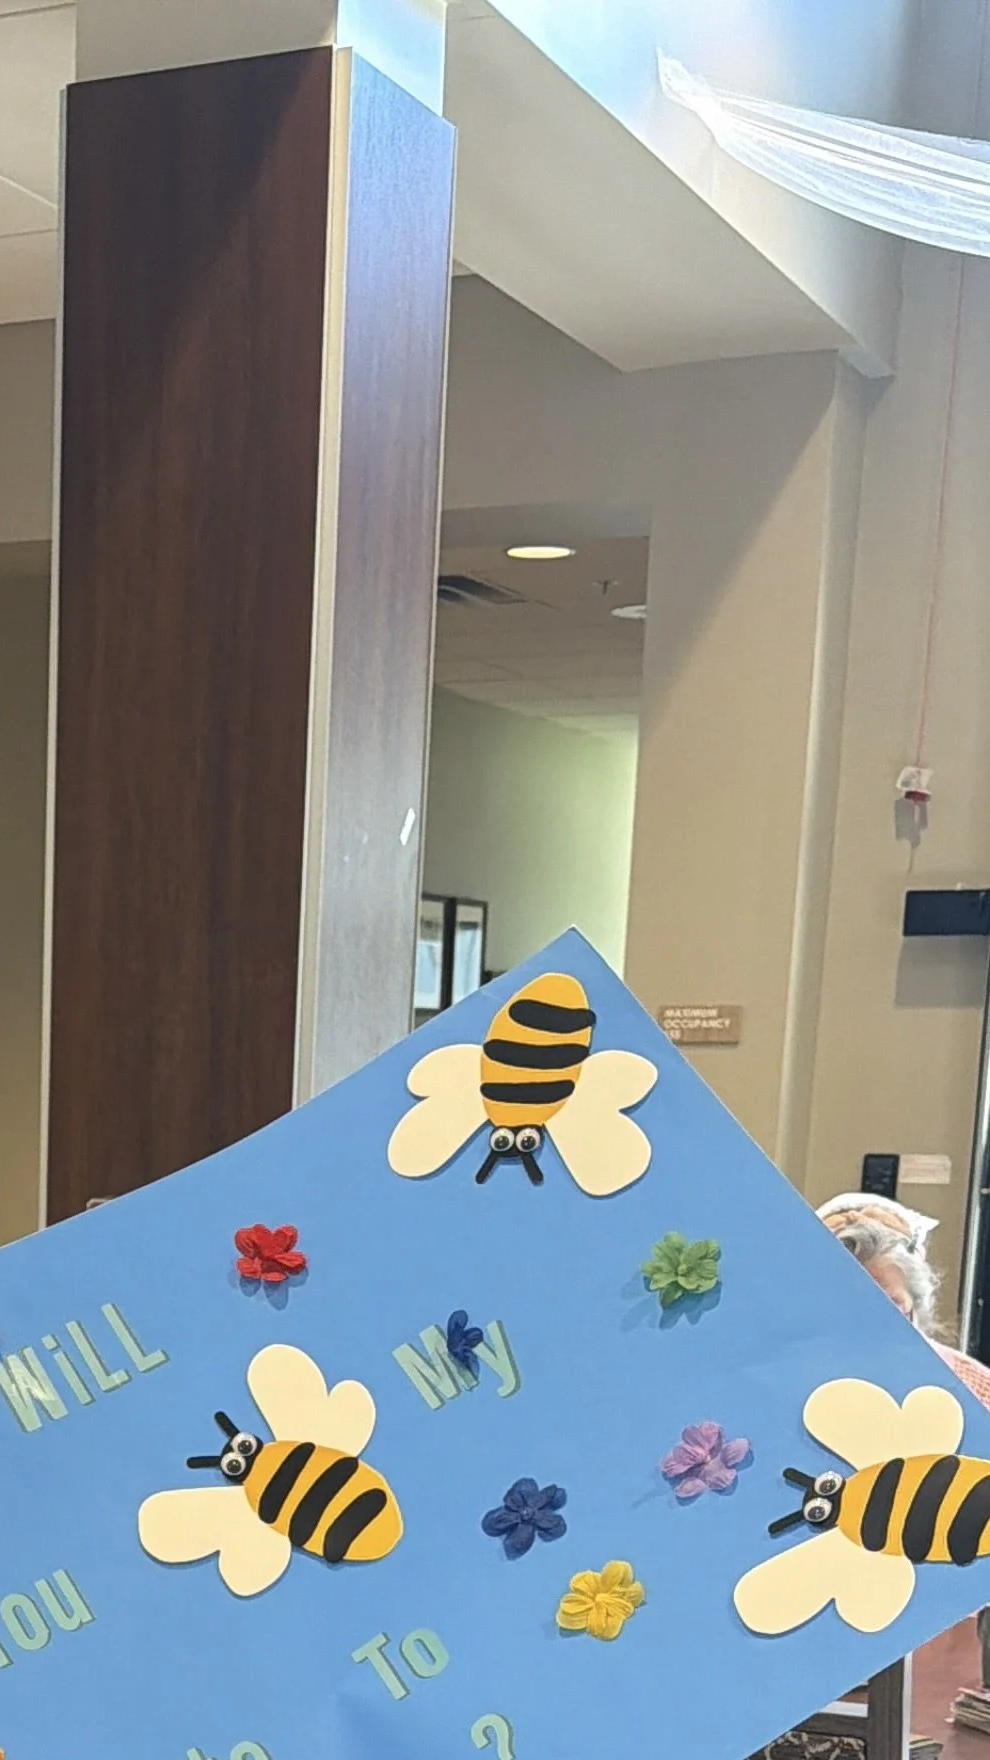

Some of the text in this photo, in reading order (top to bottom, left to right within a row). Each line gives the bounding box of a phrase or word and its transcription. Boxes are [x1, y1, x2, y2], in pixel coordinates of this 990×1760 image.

[663, 1018, 731, 1029] OCCUPANCY
[664, 1007, 718, 1018] MAXIMUM
[392, 1319, 521, 1411] My
[351, 1628, 449, 1701] To
